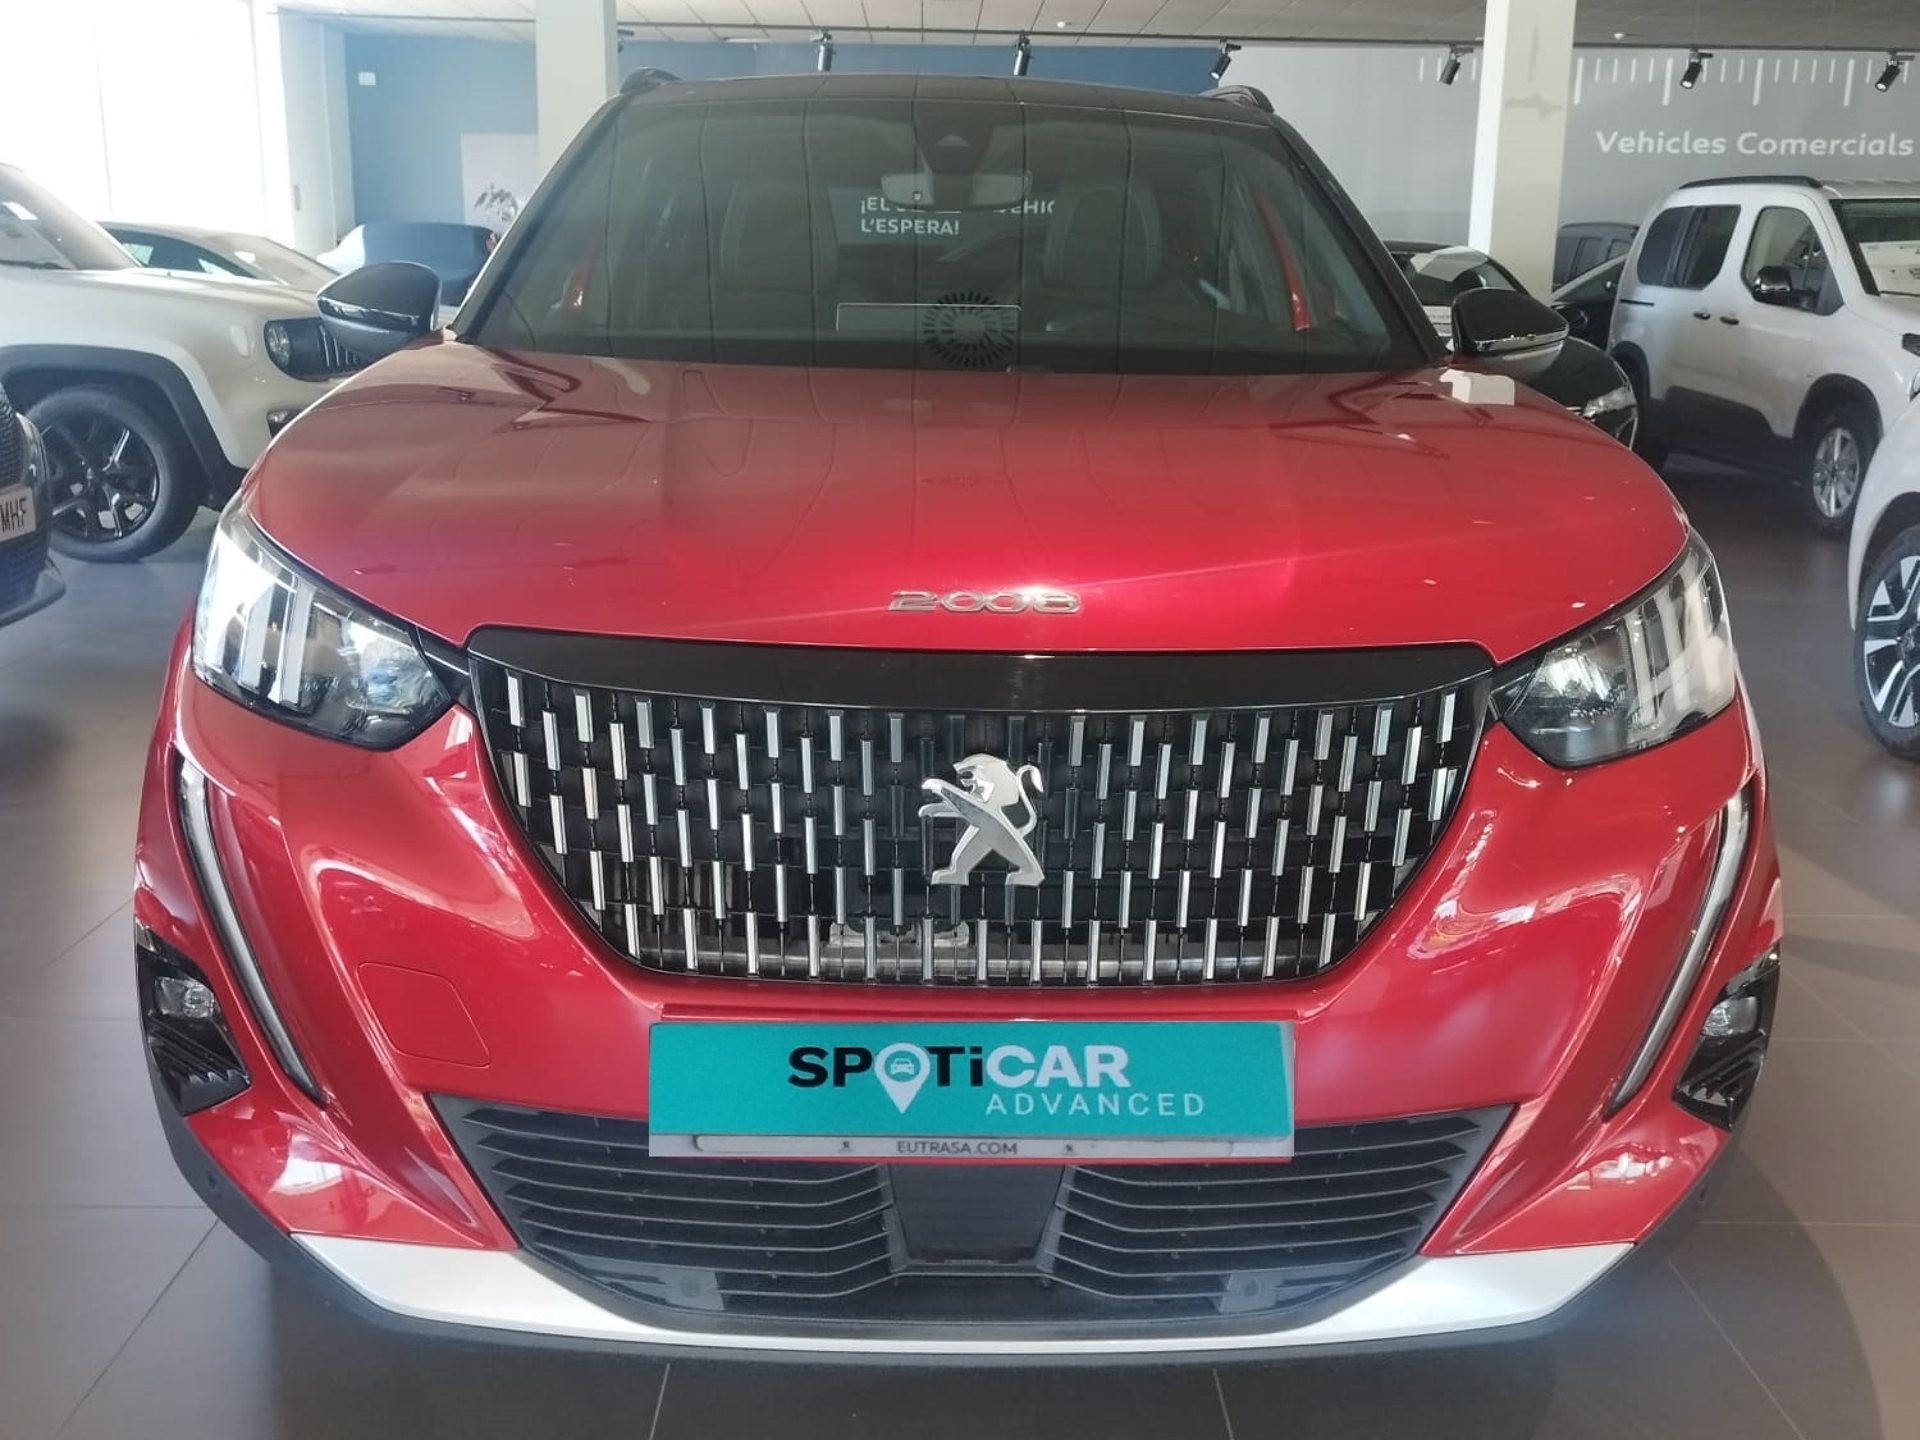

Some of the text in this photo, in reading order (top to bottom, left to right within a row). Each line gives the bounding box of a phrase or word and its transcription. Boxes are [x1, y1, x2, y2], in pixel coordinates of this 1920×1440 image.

[1596, 130, 1914, 156] Vehicles Comercials
[860, 217, 960, 236] L'ESPERA!
[888, 589, 1082, 613] 2008
[985, 1092, 1205, 1116] ADVANCED
